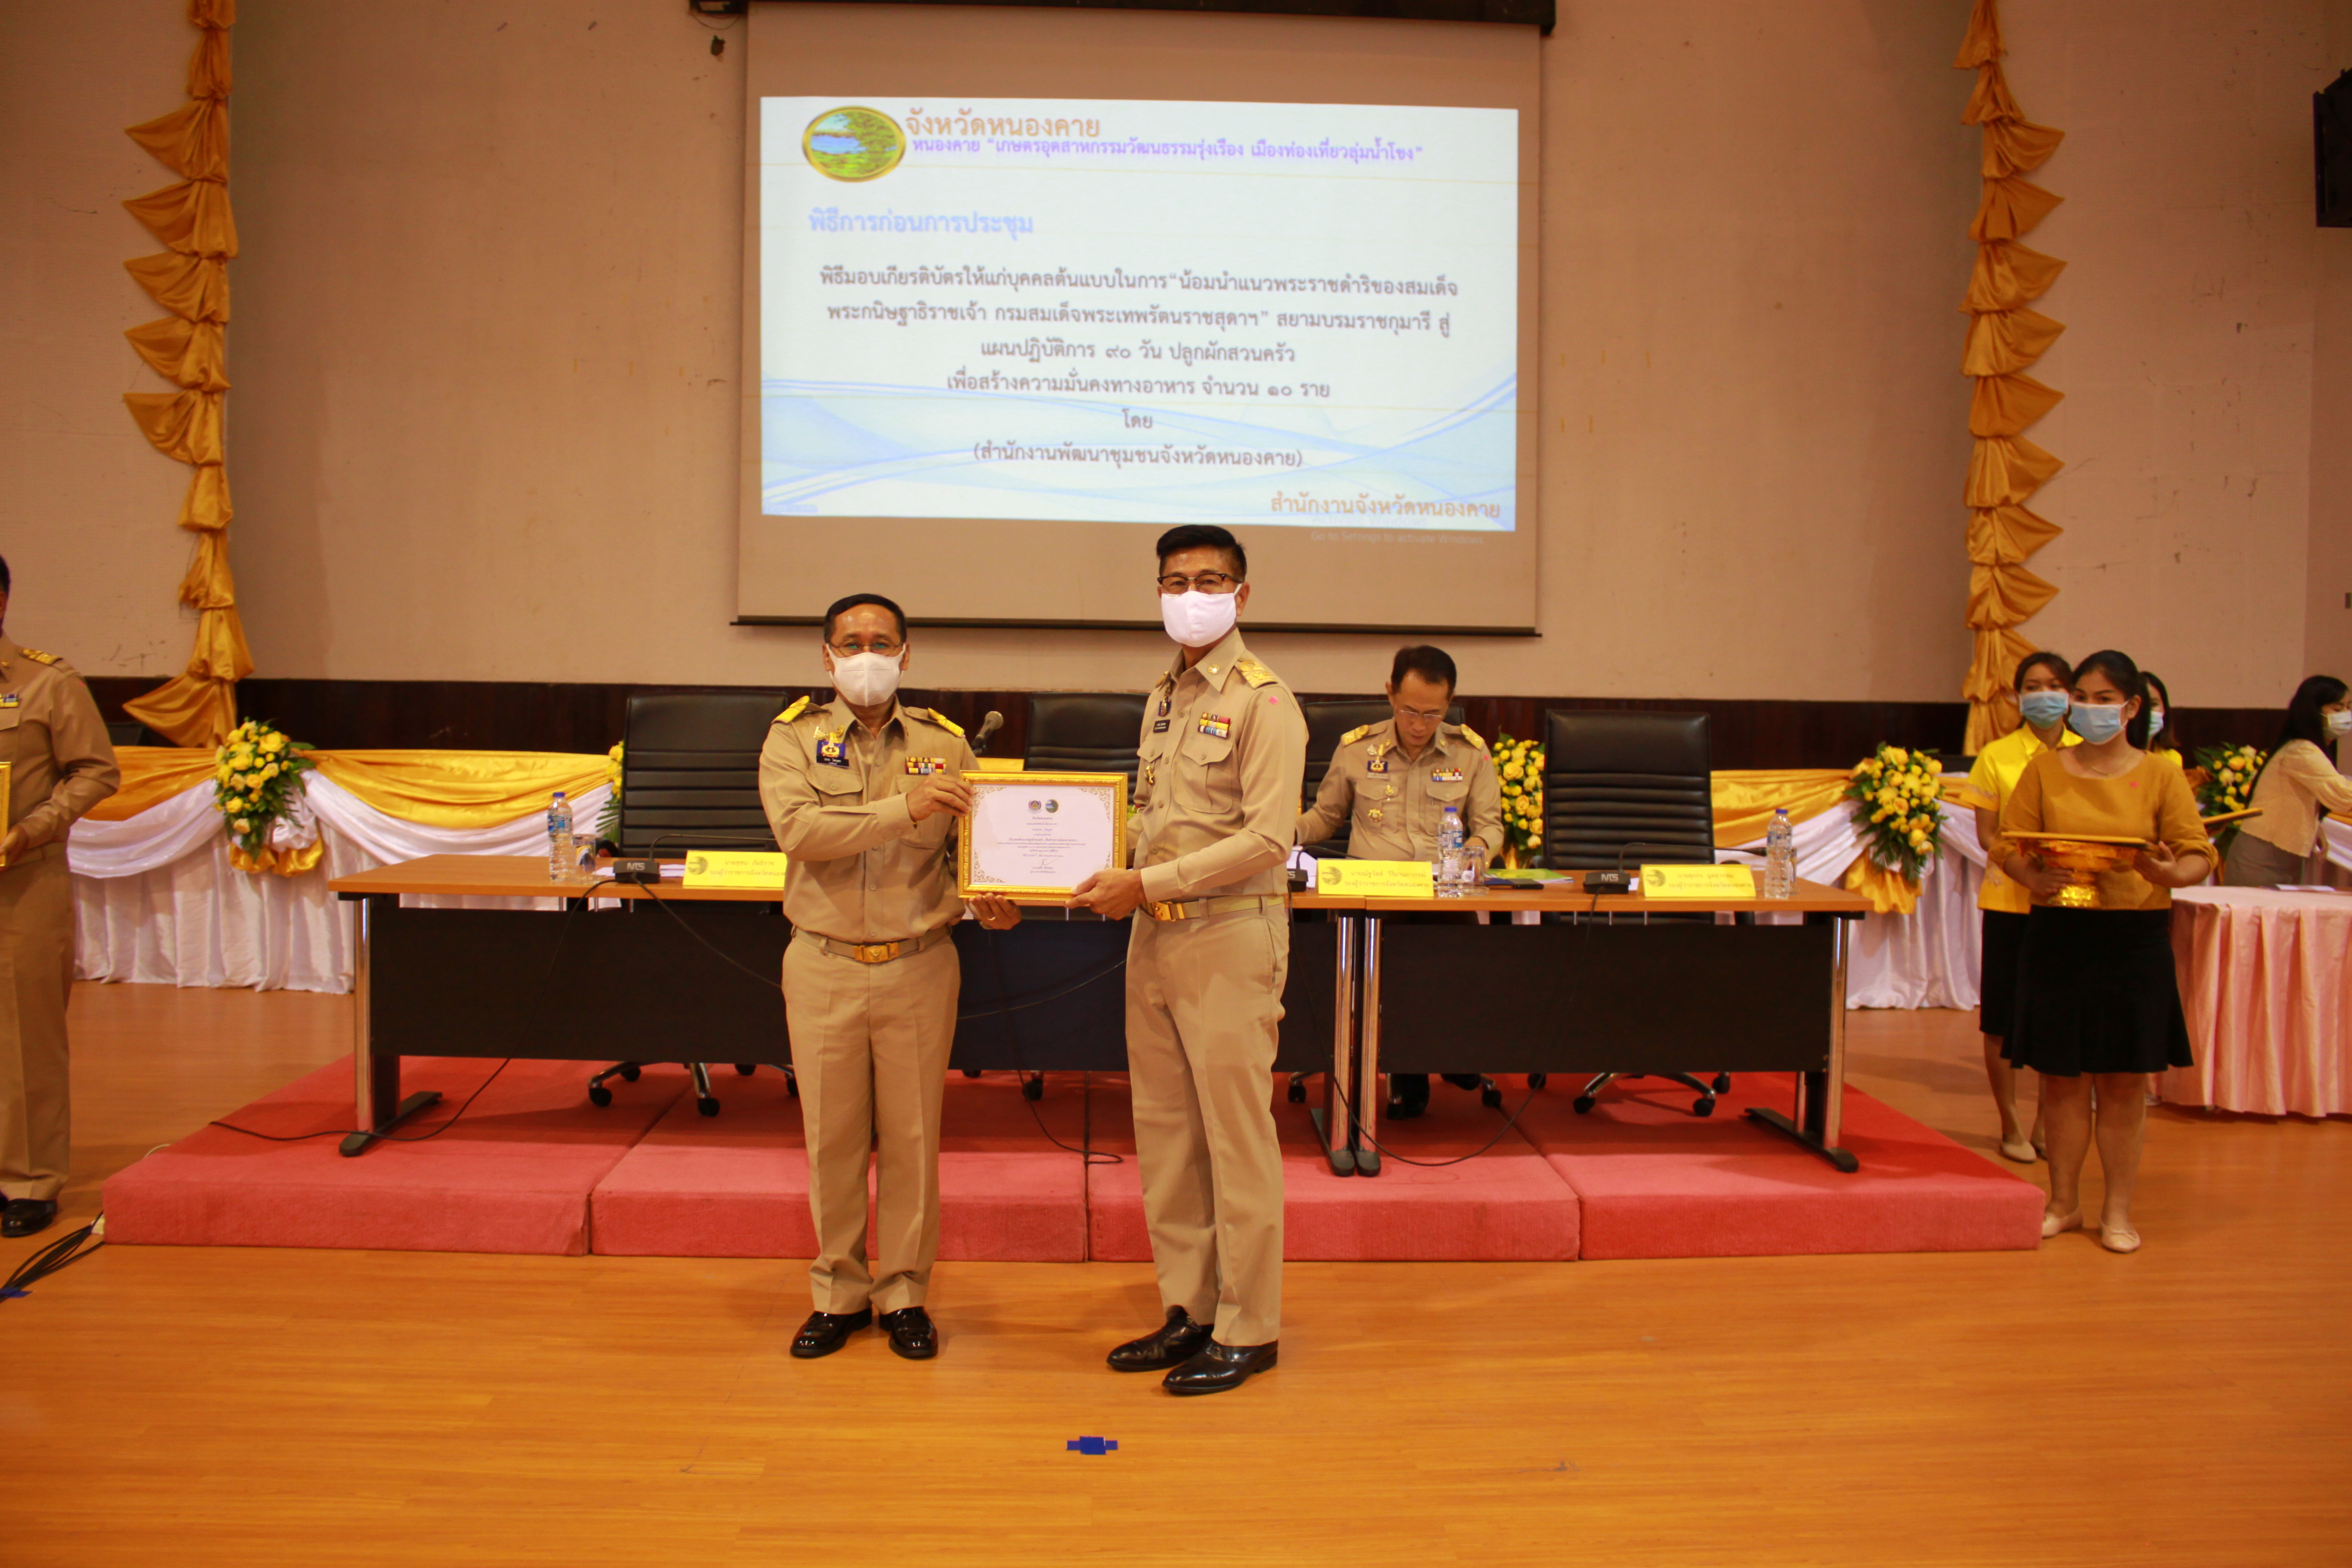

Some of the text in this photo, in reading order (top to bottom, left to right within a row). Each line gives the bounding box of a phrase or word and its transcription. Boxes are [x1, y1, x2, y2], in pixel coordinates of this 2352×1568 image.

[905, 108, 1100, 137] จังหวัดหนองคาย
[913, 140, 980, 152] หนองคาย
[810, 208, 1032, 241] พิธีการก่อนการประชุม
[827, 300, 986, 327] พระกนิษฐาธิราชเจ้า
[1276, 310, 1430, 336] สยามบรมราชกุมารี
[1439, 312, 1450, 338] สู่
[981, 337, 1295, 366] แผนปฏิบัติการ ๙๐ วัน ปลูกผักสวนครัว
[947, 366, 1330, 398] เพื่อสร้างความมั่นคงทางอาหาร จำนวน ๑๐ ราย
[1122, 407, 1153, 429] โดย
[974, 440, 1302, 468] (สำนักงานพัฒนาชุมชนจังหวัดหนองคาย)
[1271, 491, 1500, 517] สำนักงานจังหวัดหนองคาย
